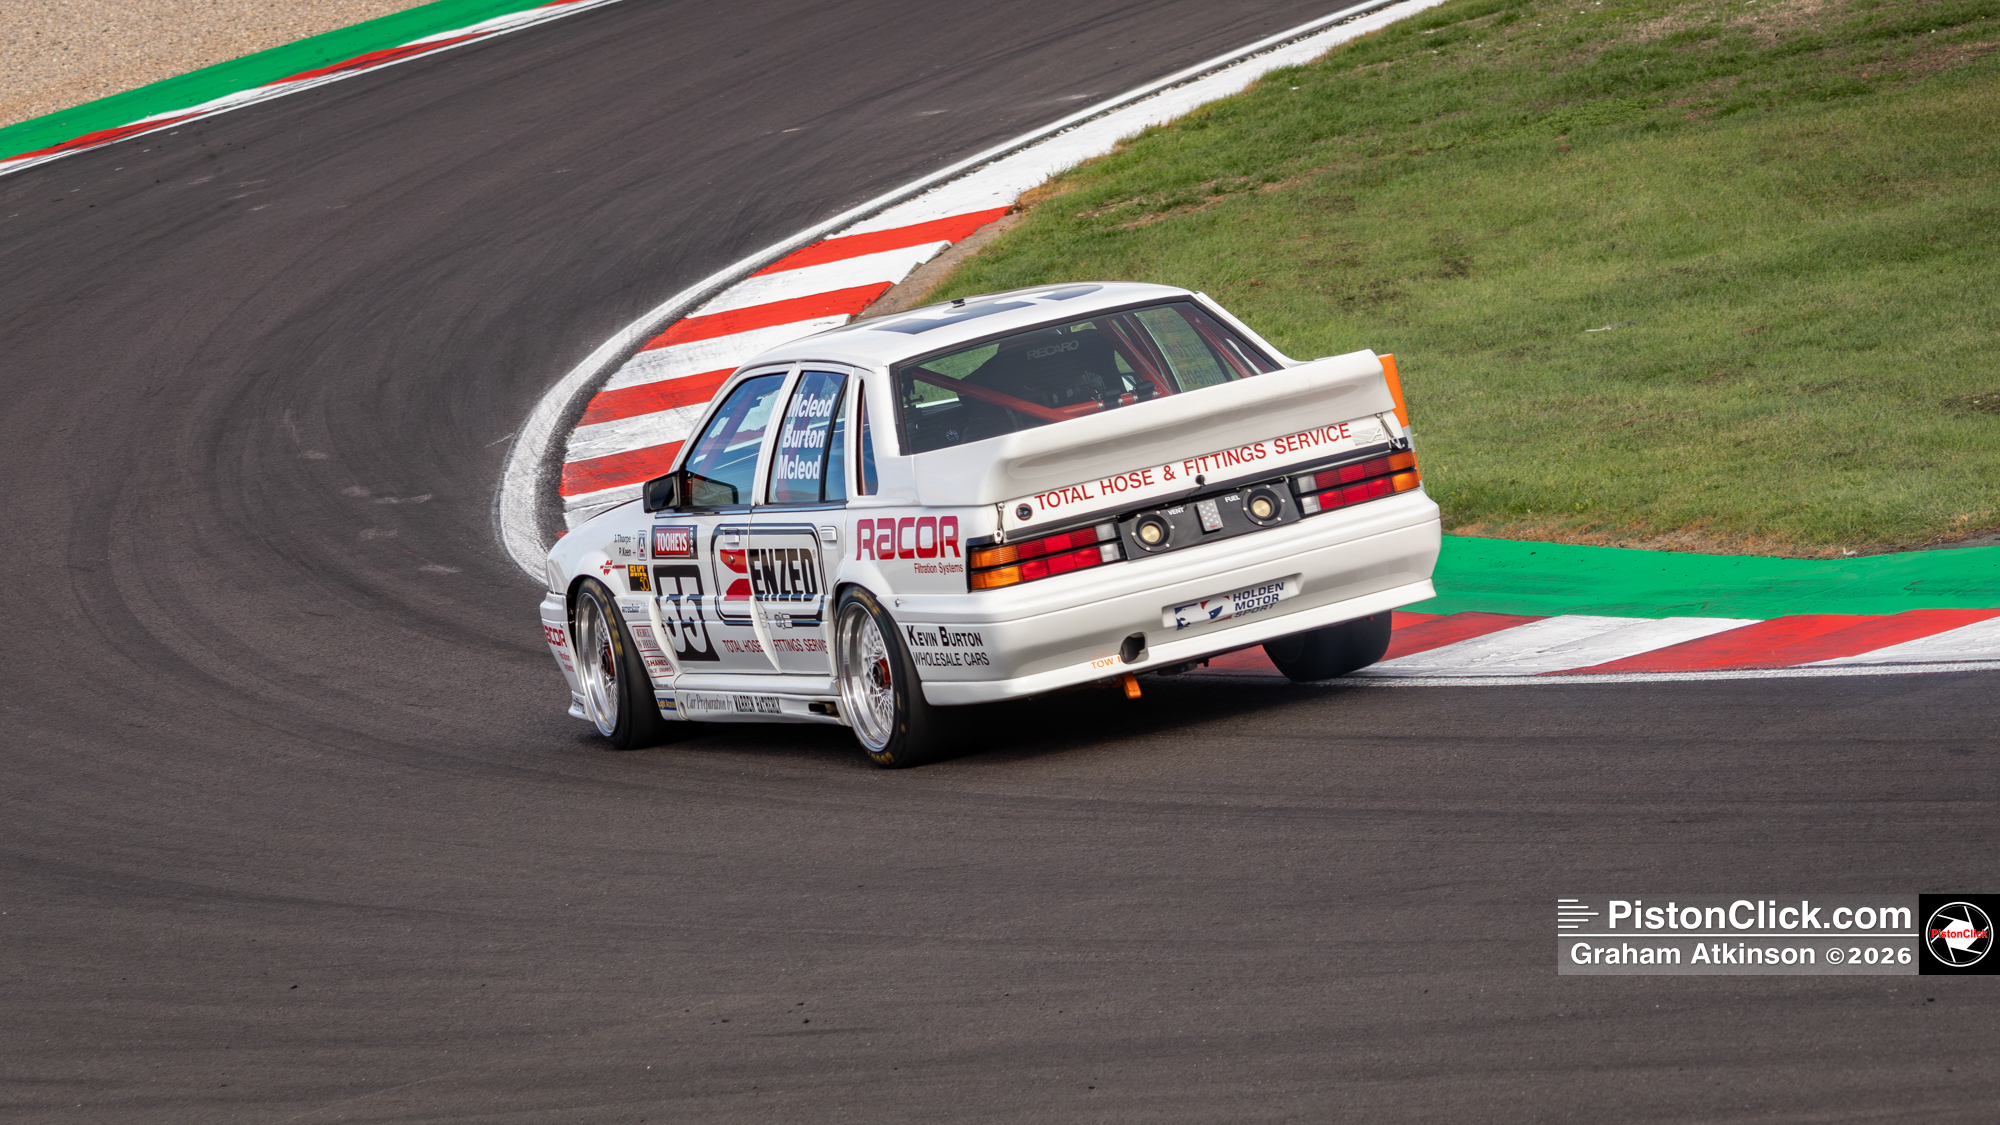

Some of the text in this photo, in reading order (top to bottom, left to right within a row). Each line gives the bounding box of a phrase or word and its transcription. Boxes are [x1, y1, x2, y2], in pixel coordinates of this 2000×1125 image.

[1026, 340, 1079, 360] RECARO
[788, 393, 836, 417] Mcleod
[782, 424, 826, 449] Burton
[777, 455, 821, 480] Mcleod
[1034, 423, 1352, 511] TOTAL HOSE & FITTINGS SERVICE
[1224, 494, 1241, 503] FUEL
[1168, 507, 1185, 516] VENT
[656, 532, 688, 552] TOOHEYS
[747, 548, 819, 602] ENZED
[913, 561, 964, 576] Filtration Systems
[1233, 581, 1285, 603] HOLDEN
[1234, 593, 1280, 612] MOTOR
[1234, 602, 1278, 618] SPORT
[722, 639, 746, 653] TOTAL
[742, 639, 765, 653] HOSE
[906, 625, 984, 647] KEVIN BURTON
[912, 651, 990, 667] WHOLESALE CARS
[1090, 657, 1114, 669] TOW
